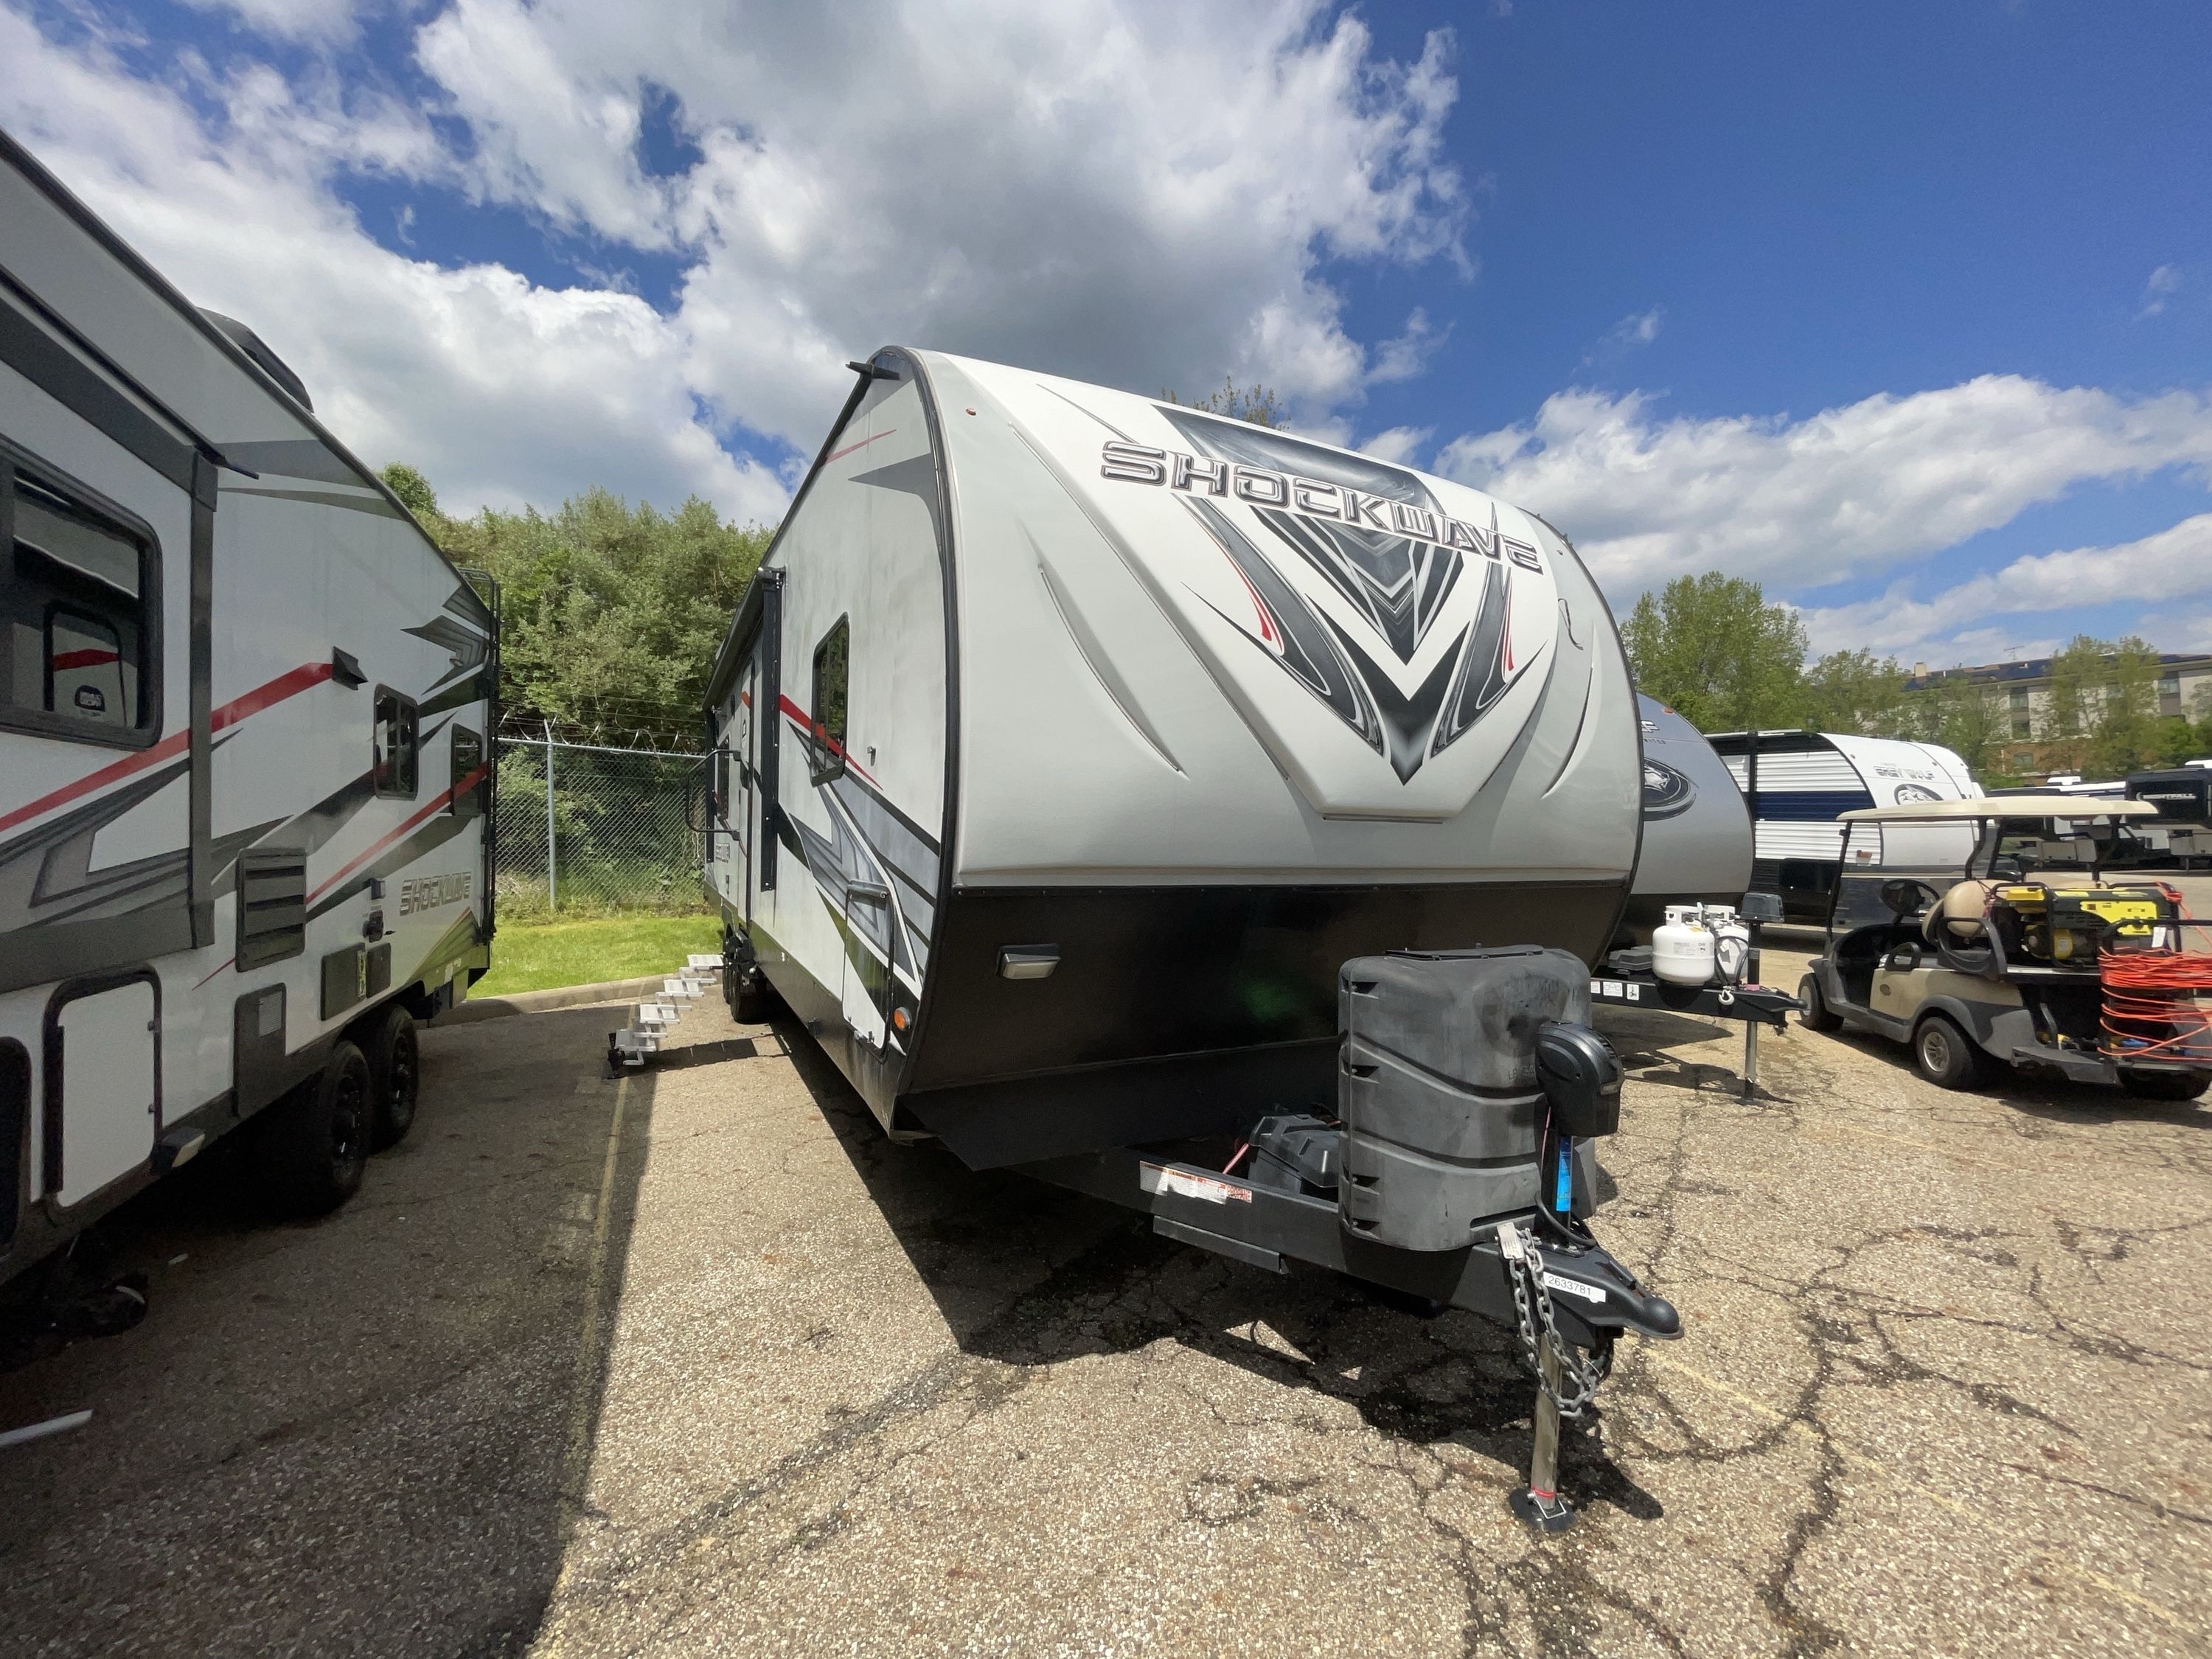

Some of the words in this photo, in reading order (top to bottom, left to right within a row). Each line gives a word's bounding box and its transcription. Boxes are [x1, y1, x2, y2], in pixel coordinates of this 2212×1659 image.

[1102, 440, 1545, 575] SHOCKWAVE
[400, 872, 471, 916] SHOCKWAVE
[1548, 1276, 1591, 1295] 2633781
